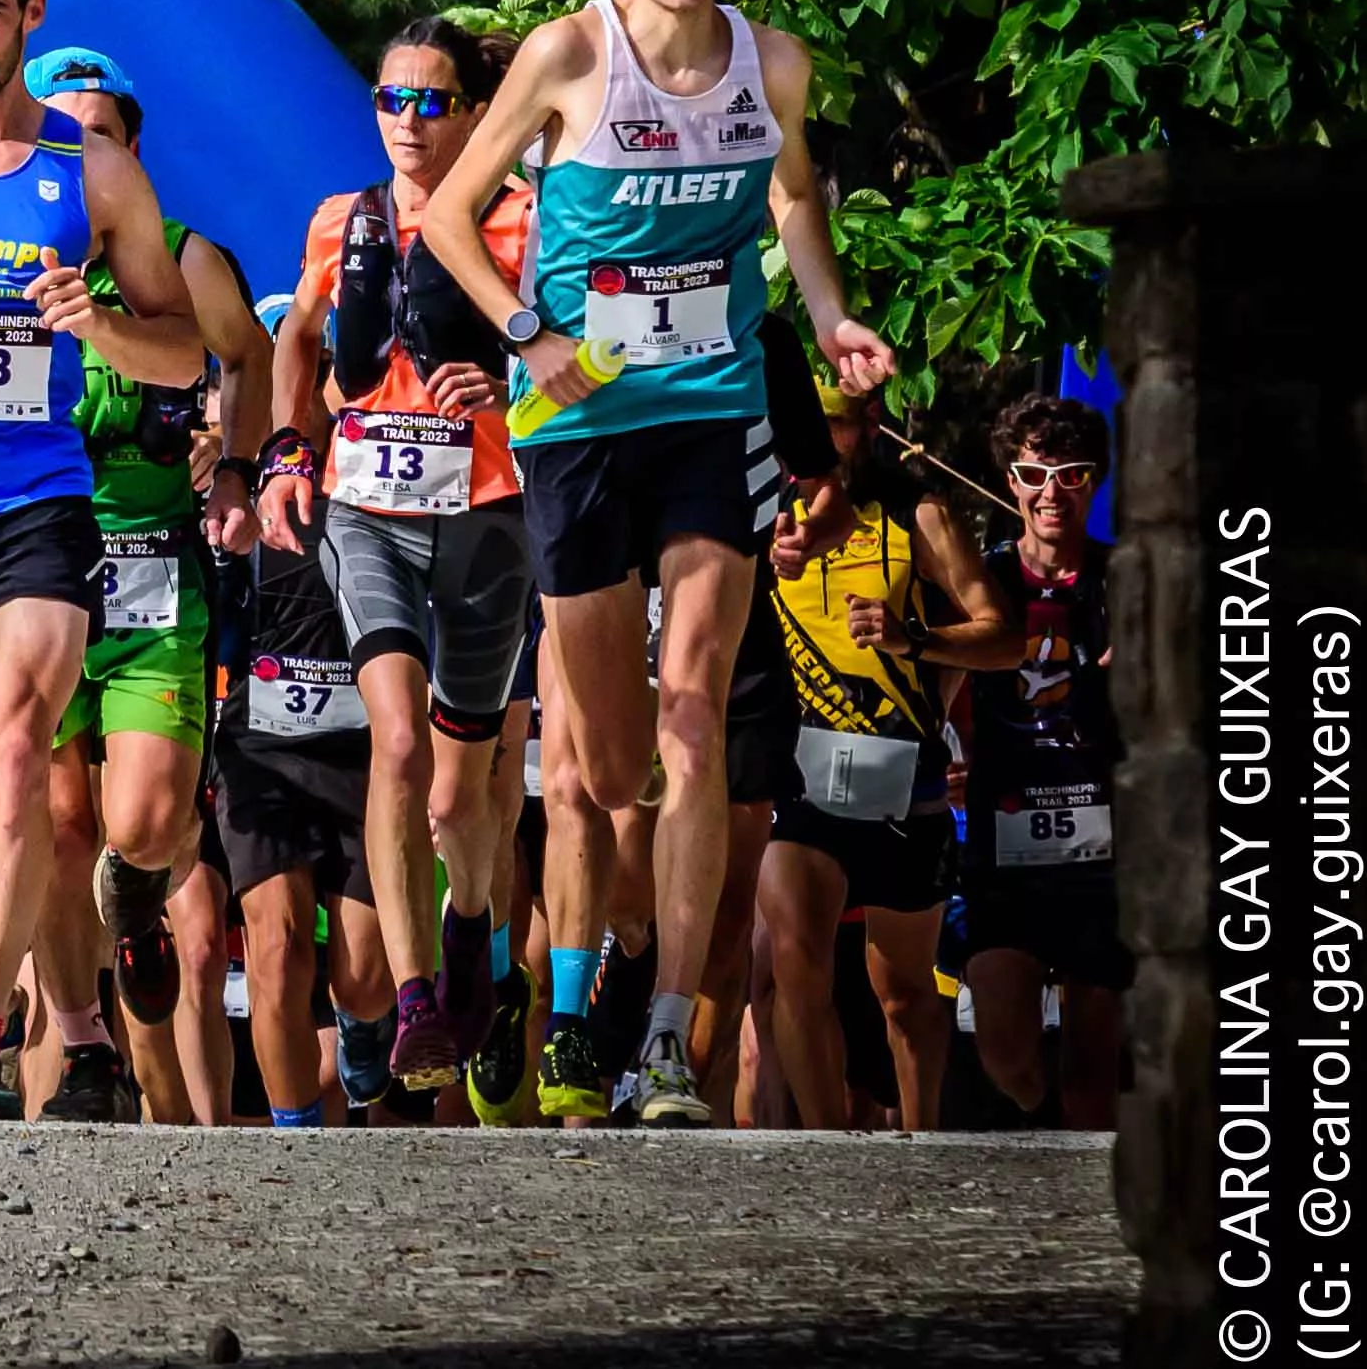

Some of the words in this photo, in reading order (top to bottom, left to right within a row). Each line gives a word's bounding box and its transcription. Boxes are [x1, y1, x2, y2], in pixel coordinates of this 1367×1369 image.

[610, 169, 747, 206] ATLEET
[629, 259, 724, 278] TRASCHINEPRO
[643, 280, 680, 292] TRAIL
[683, 274, 710, 287] 2023
[652, 297, 674, 334] 1
[5, 331, 34, 343] 2023
[381, 427, 417, 441] TRAIL
[419, 431, 451, 443] 2023
[374, 445, 424, 481] 13
[293, 670, 323, 682] TRAIL
[326, 673, 352, 683] 2023
[284, 684, 333, 716] 37
[296, 716, 317, 726] LUIS
[1030, 810, 1076, 841] 85
